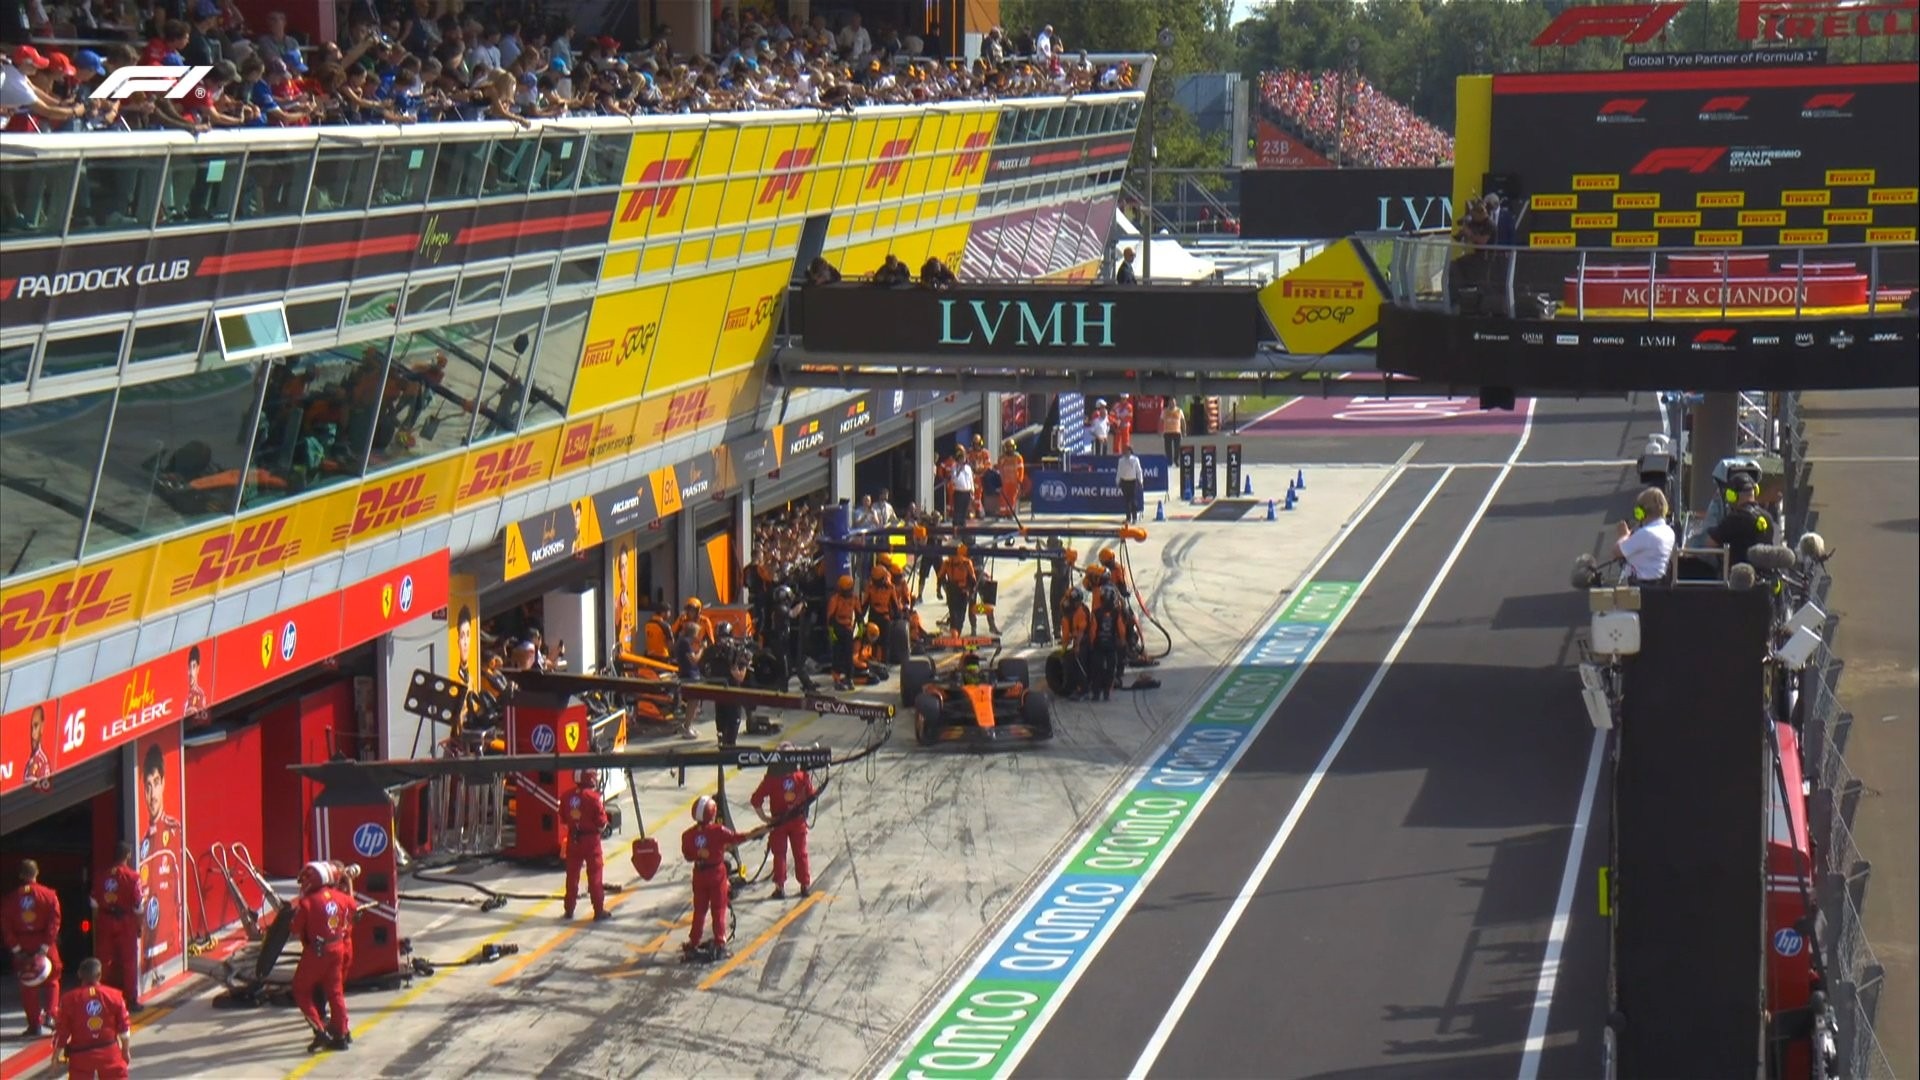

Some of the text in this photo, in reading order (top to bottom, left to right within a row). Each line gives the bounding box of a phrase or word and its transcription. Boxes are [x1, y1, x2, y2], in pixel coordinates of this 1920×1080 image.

[1628, 54, 1665, 66] Global
[1668, 53, 1693, 66] Tyre
[1695, 52, 1737, 64] Partner
[1741, 51, 1754, 63] of
[1756, 50, 1803, 63] Formula
[1263, 141, 1289, 155] 23B
[1730, 149, 1801, 159] GRAN PREMIO
[866, 138, 913, 190] F1
[1630, 146, 1729, 175] F1
[758, 147, 817, 206] F1
[1576, 177, 1616, 187] PIRELLI
[1829, 173, 1870, 182] PIRELLI
[620, 158, 693, 223] F1
[1700, 195, 1740, 204] PIRELLI
[1785, 193, 1825, 203] PIRELLI
[1872, 191, 1913, 201] PIRELLI
[1535, 197, 1573, 207] PIRELLI
[1616, 196, 1656, 206] PIRELLI
[1575, 216, 1613, 225] PIRELLI
[1657, 214, 1697, 224] PIRELLI
[1742, 213, 1782, 223] PIRELLI
[1827, 212, 1868, 221] PIRELLI
[1533, 235, 1571, 245] PIRELLI
[1615, 234, 1655, 243] PIRELLI
[1698, 233, 1738, 243] PIRELLI
[1783, 232, 1823, 241] PIRELLI
[1870, 231, 1911, 240] PIRELLI
[1713, 262, 1722, 273] 1
[17, 259, 190, 299] PADDOCK CLUB
[1283, 280, 1364, 299] PIRELLI
[1622, 283, 1808, 304] MOËT & CHANDON
[724, 306, 751, 332] PIRELLI
[939, 301, 1116, 346] LVMH
[1292, 305, 1354, 325] 500GP
[1640, 336, 1676, 346] LVMH
[1752, 336, 1780, 344] PIRELLI
[581, 339, 616, 369] PIRELLI
[840, 411, 870, 434] HOT LAPS
[791, 431, 824, 455] HOT LAPS
[1184, 455, 1191, 467] 3
[1205, 455, 1213, 467] 2
[1231, 454, 1238, 465] 1
[469, 442, 535, 498] DHL
[682, 480, 708, 500] PIASTRI
[1041, 482, 1066, 498] FIA
[1071, 487, 1097, 497] PARC
[351, 473, 427, 527] DHL
[611, 495, 640, 516] McLaren
[189, 516, 289, 588] DHL
[507, 535, 517, 567] 4
[531, 539, 565, 563] NORRIS
[0, 569, 113, 651] DHL
[1206, 673, 1283, 720] aramco
[102, 698, 173, 742] LECLERC
[850, 709, 886, 718] LOGISTICS
[63, 708, 86, 753] 16
[536, 725, 552, 753] hp
[784, 754, 832, 763] LOGISTICS
[1151, 729, 1242, 786] aramco
[360, 824, 383, 857] hp
[1085, 797, 1188, 871] aramco
[1000, 882, 1124, 972] aramco
[1778, 929, 1799, 955] hp
